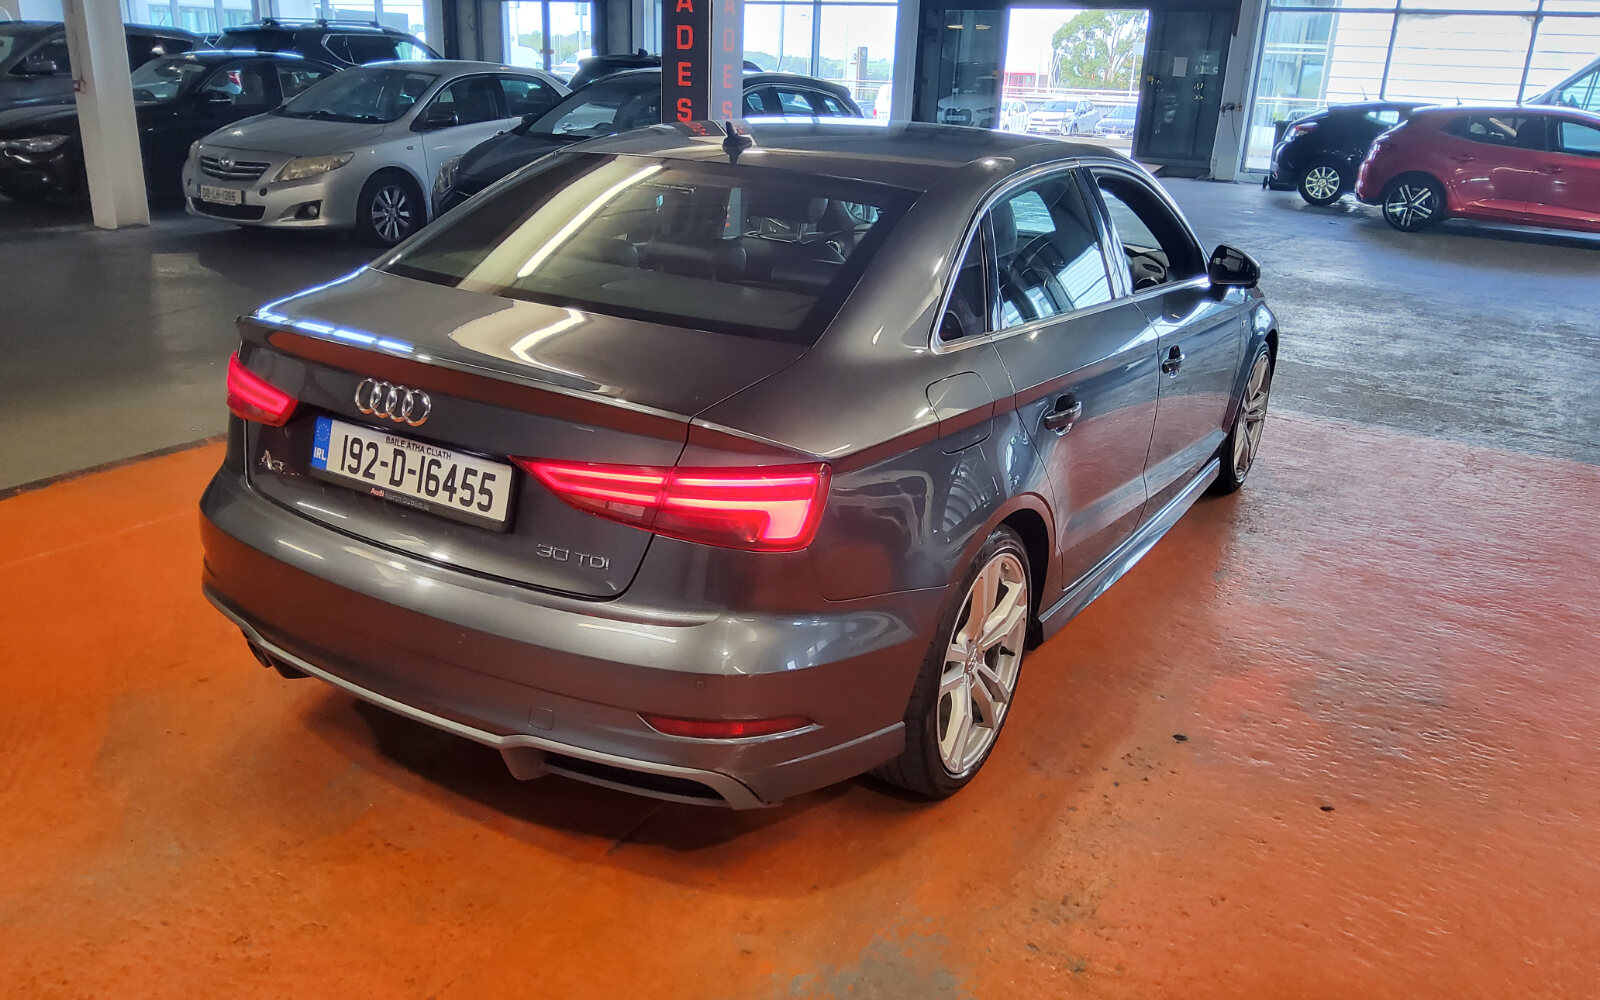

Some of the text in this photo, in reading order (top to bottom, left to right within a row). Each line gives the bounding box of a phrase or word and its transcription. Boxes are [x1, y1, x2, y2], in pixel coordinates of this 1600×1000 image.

[313, 446, 327, 461] IRL
[385, 436, 406, 448] BAILE
[426, 447, 452, 460] CLIATH
[340, 434, 497, 513] 192-D-16455
[370, 487, 385, 498] Audi
[536, 543, 611, 571] 30 TDI
